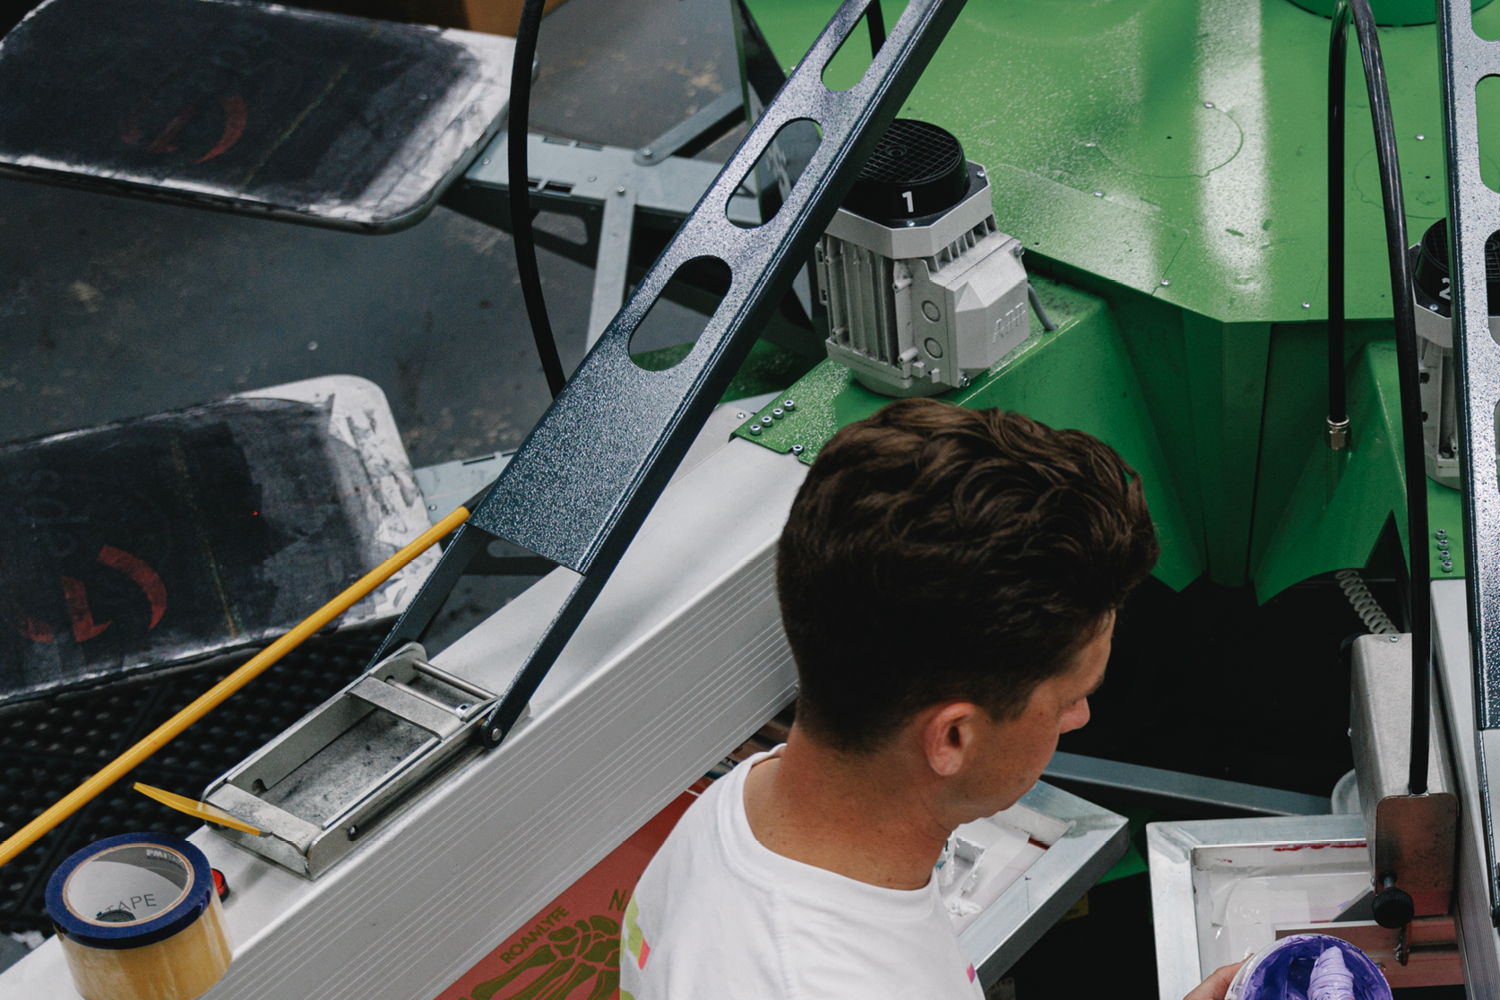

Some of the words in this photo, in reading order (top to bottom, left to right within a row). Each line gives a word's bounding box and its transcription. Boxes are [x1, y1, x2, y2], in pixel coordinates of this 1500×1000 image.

[902, 191, 914, 213] 1
[1439, 277, 1451, 300] 2
[499, 904, 570, 965] ROAMLYFE
